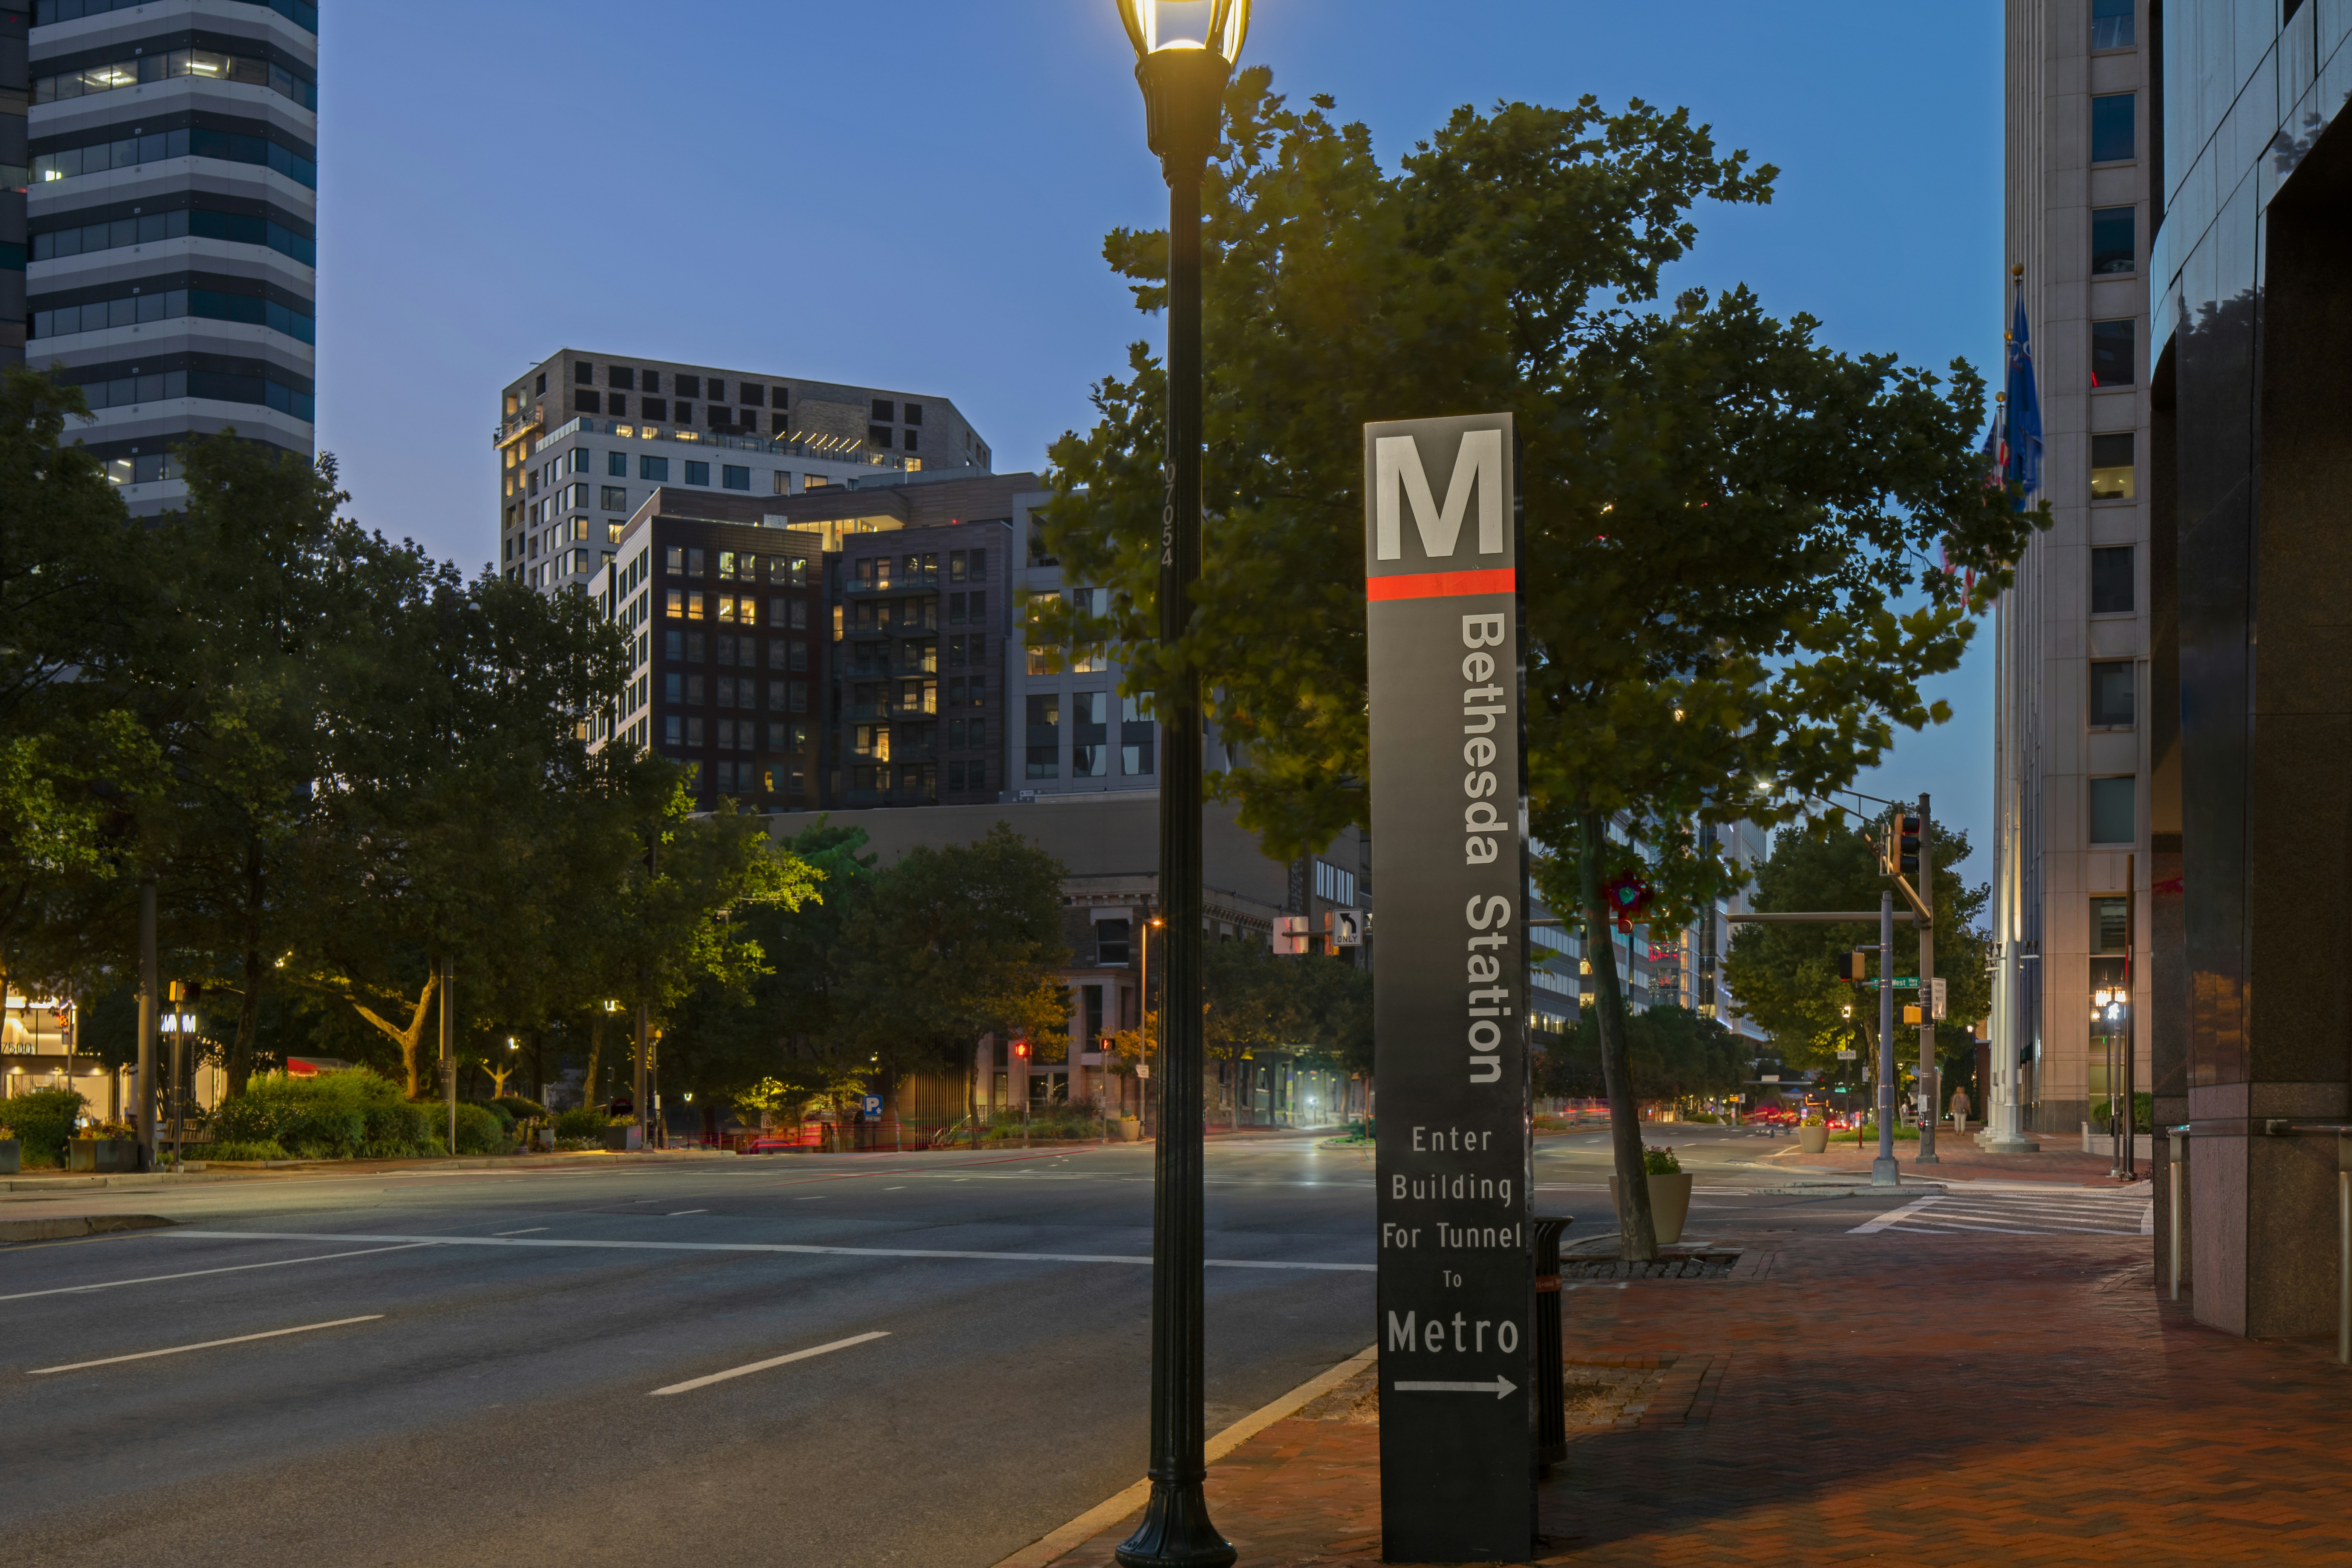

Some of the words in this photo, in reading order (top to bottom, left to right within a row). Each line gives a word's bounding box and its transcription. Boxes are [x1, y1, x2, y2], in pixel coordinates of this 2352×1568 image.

[1161, 463, 1176, 565] 07054
[1376, 429, 1503, 560] M
[1462, 613, 1508, 865] Bethesda
[1466, 895, 1511, 1083] Station
[866, 1097, 879, 1112] P
[1413, 1126, 1492, 1152] Enter
[1392, 1173, 1512, 1208] Building
[1383, 1222, 1421, 1248] For
[1437, 1222, 1521, 1248] Tunnel
[1443, 1270, 1462, 1288] To
[1388, 1310, 1519, 1353] Metro
